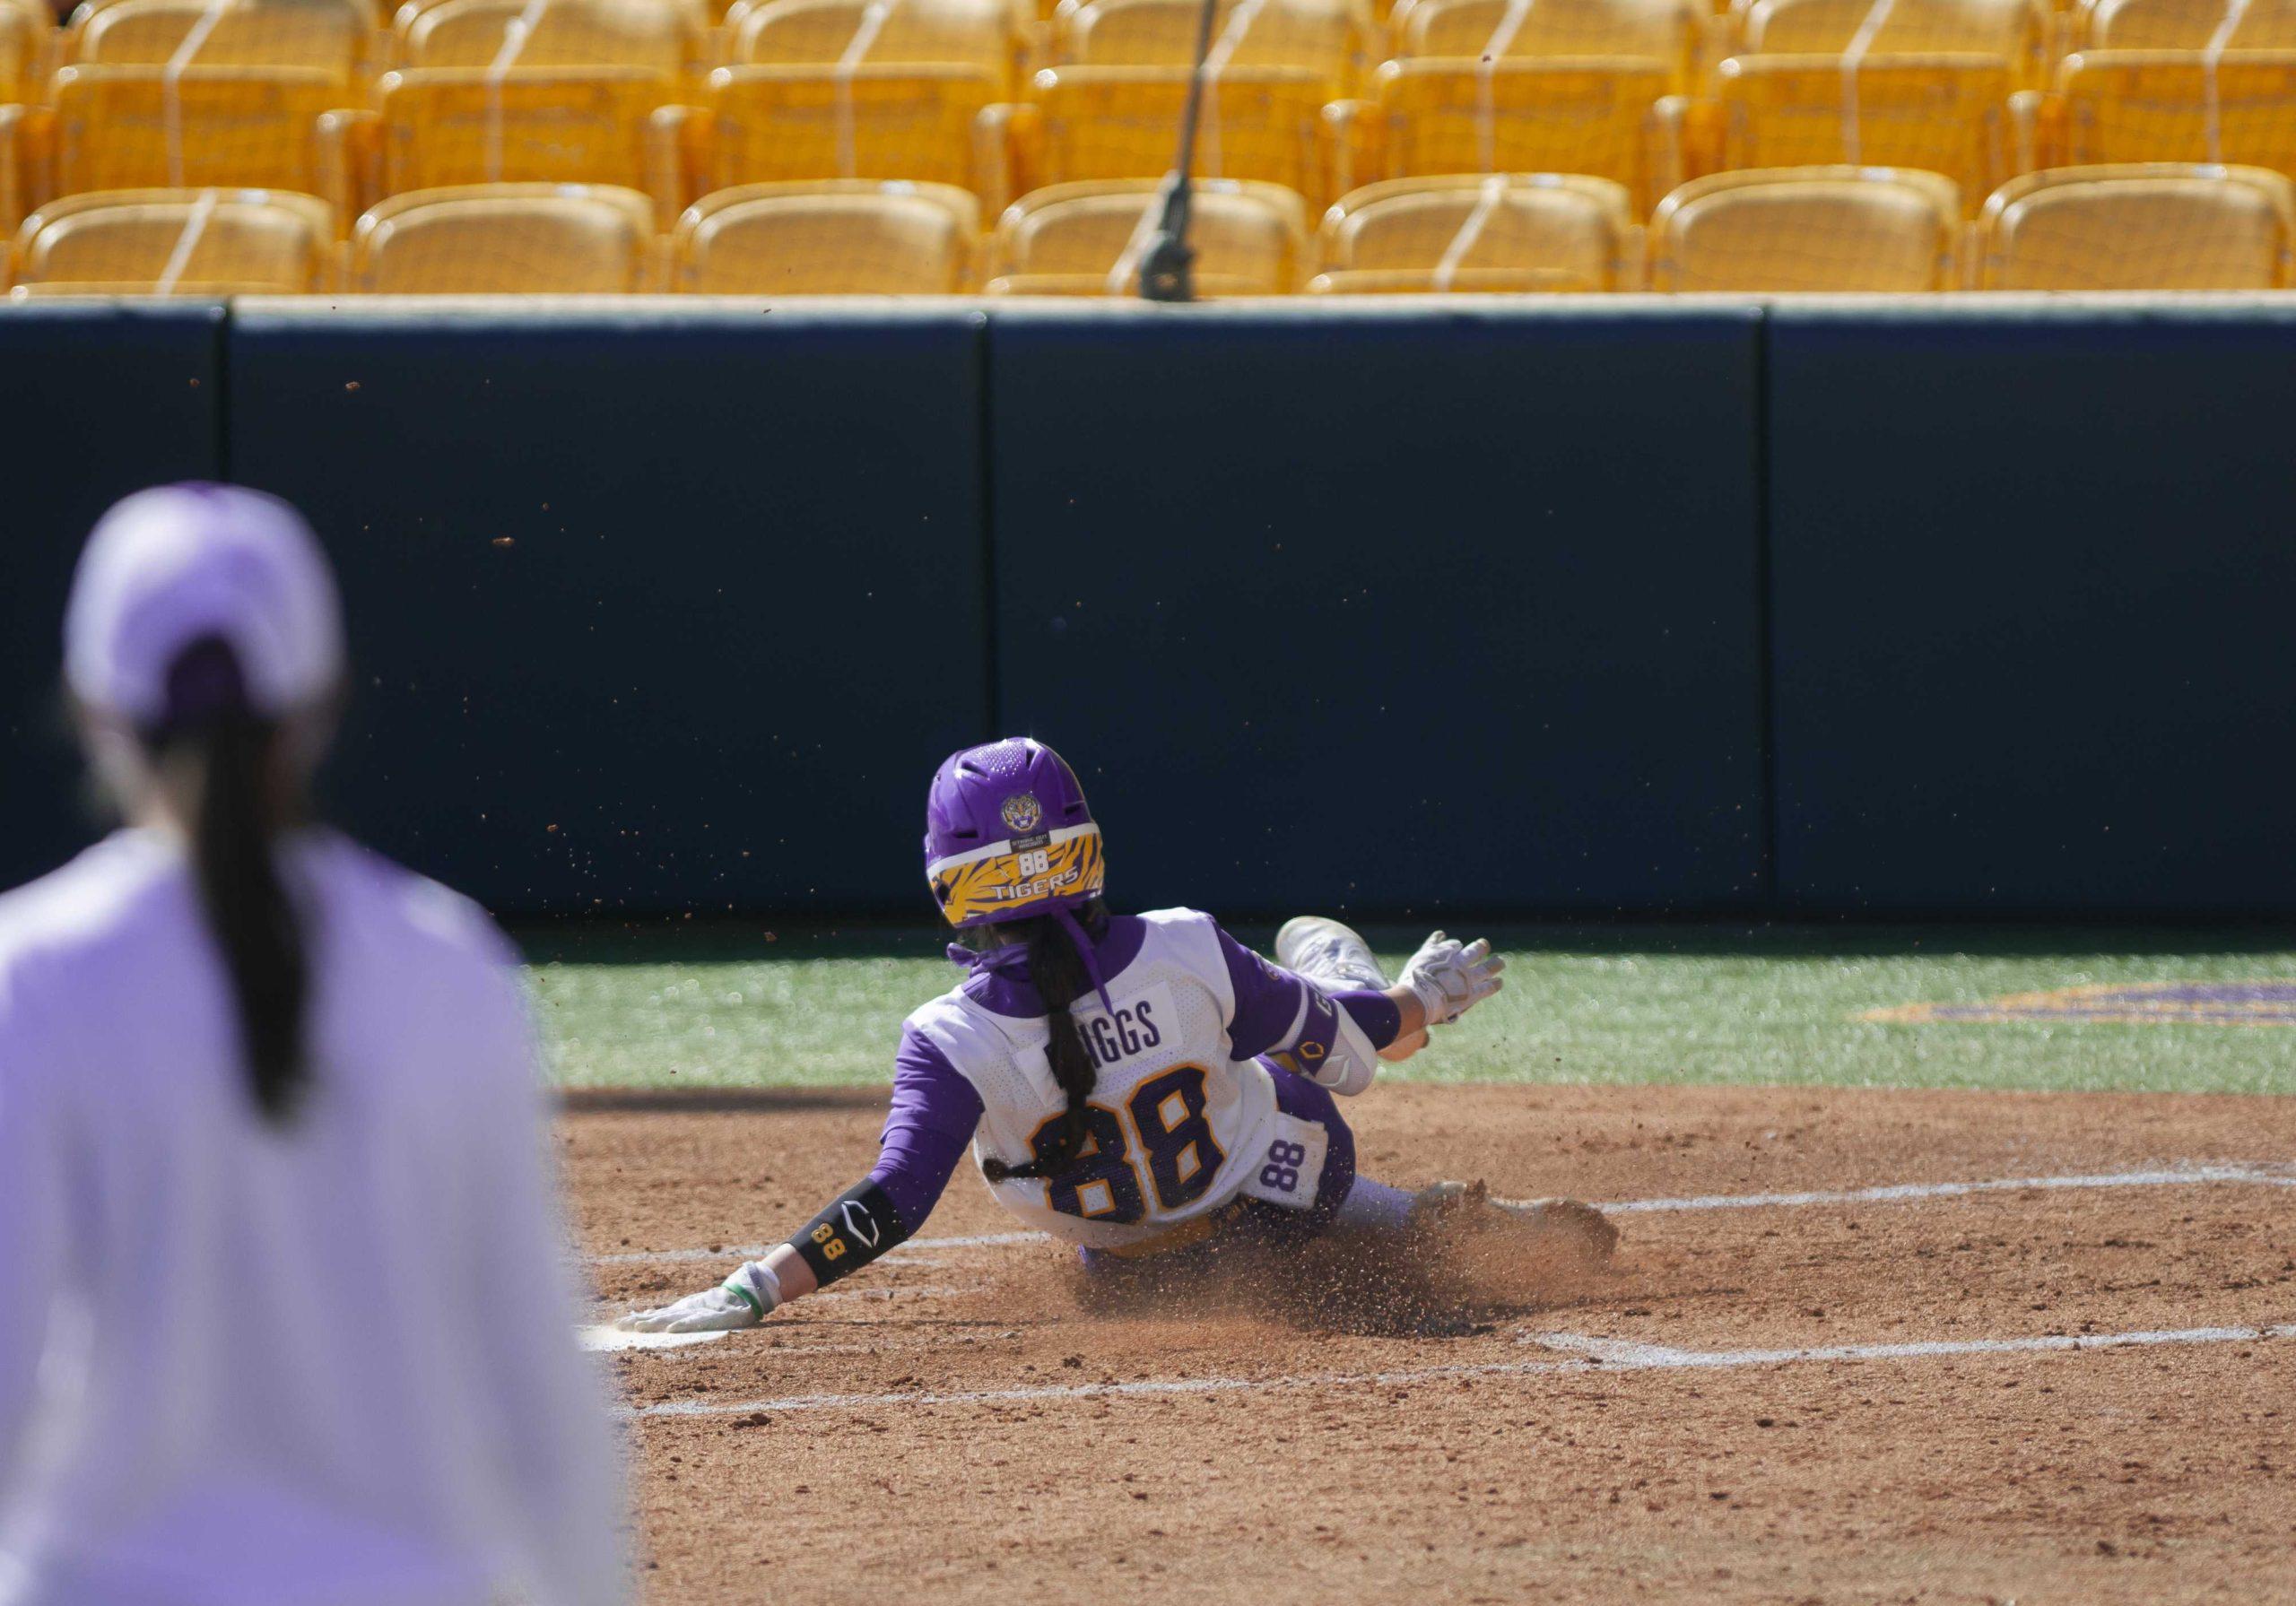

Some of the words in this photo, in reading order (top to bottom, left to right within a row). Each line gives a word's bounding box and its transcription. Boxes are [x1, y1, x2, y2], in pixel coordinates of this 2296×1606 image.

[991, 866, 1078, 899] TIGERS
[1019, 849, 1049, 877] 88
[1045, 1000, 1161, 1084] IGGS
[1025, 1062, 1228, 1225] 88
[1259, 1139, 1305, 1193] 88
[811, 1222, 846, 1261] 88
